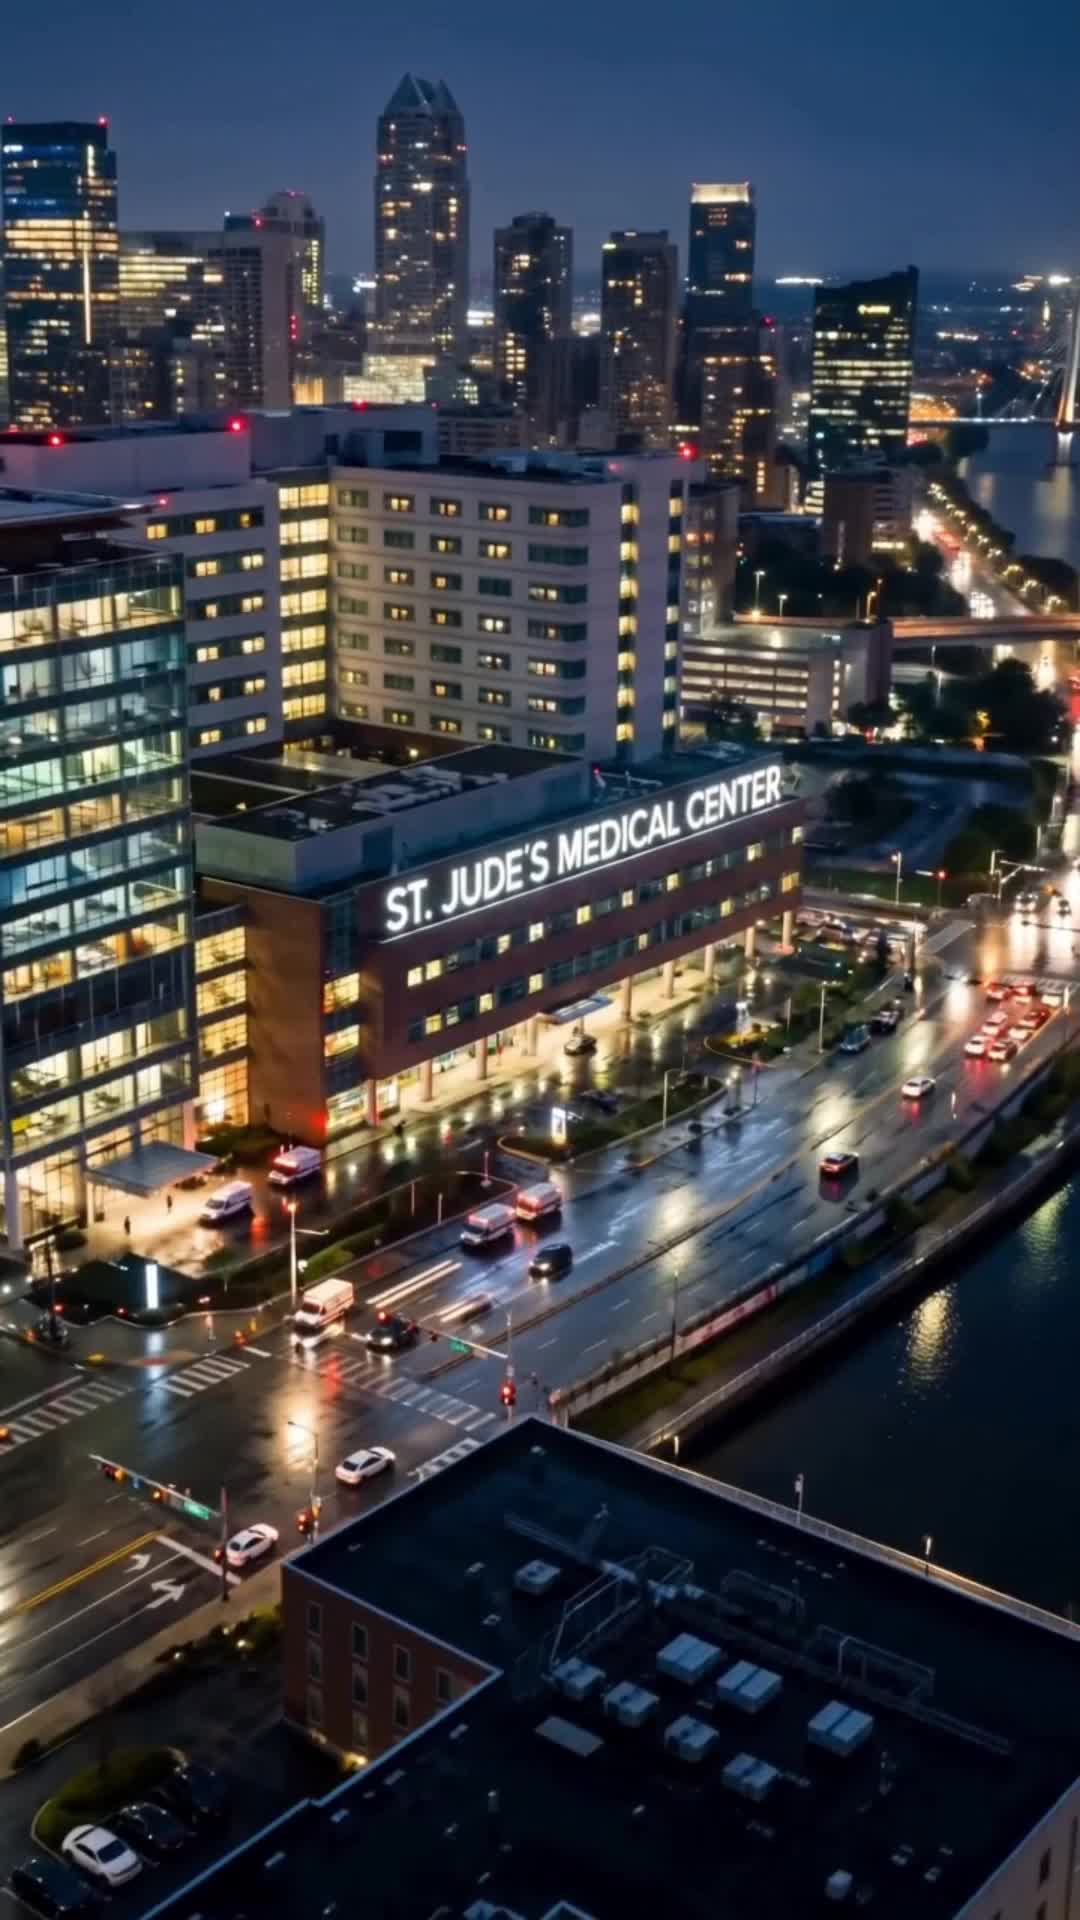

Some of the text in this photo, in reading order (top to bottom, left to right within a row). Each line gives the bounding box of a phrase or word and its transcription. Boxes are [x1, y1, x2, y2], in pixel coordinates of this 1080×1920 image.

[385, 765, 782, 932] ST. JUDE'S MEDICAL CENTER
